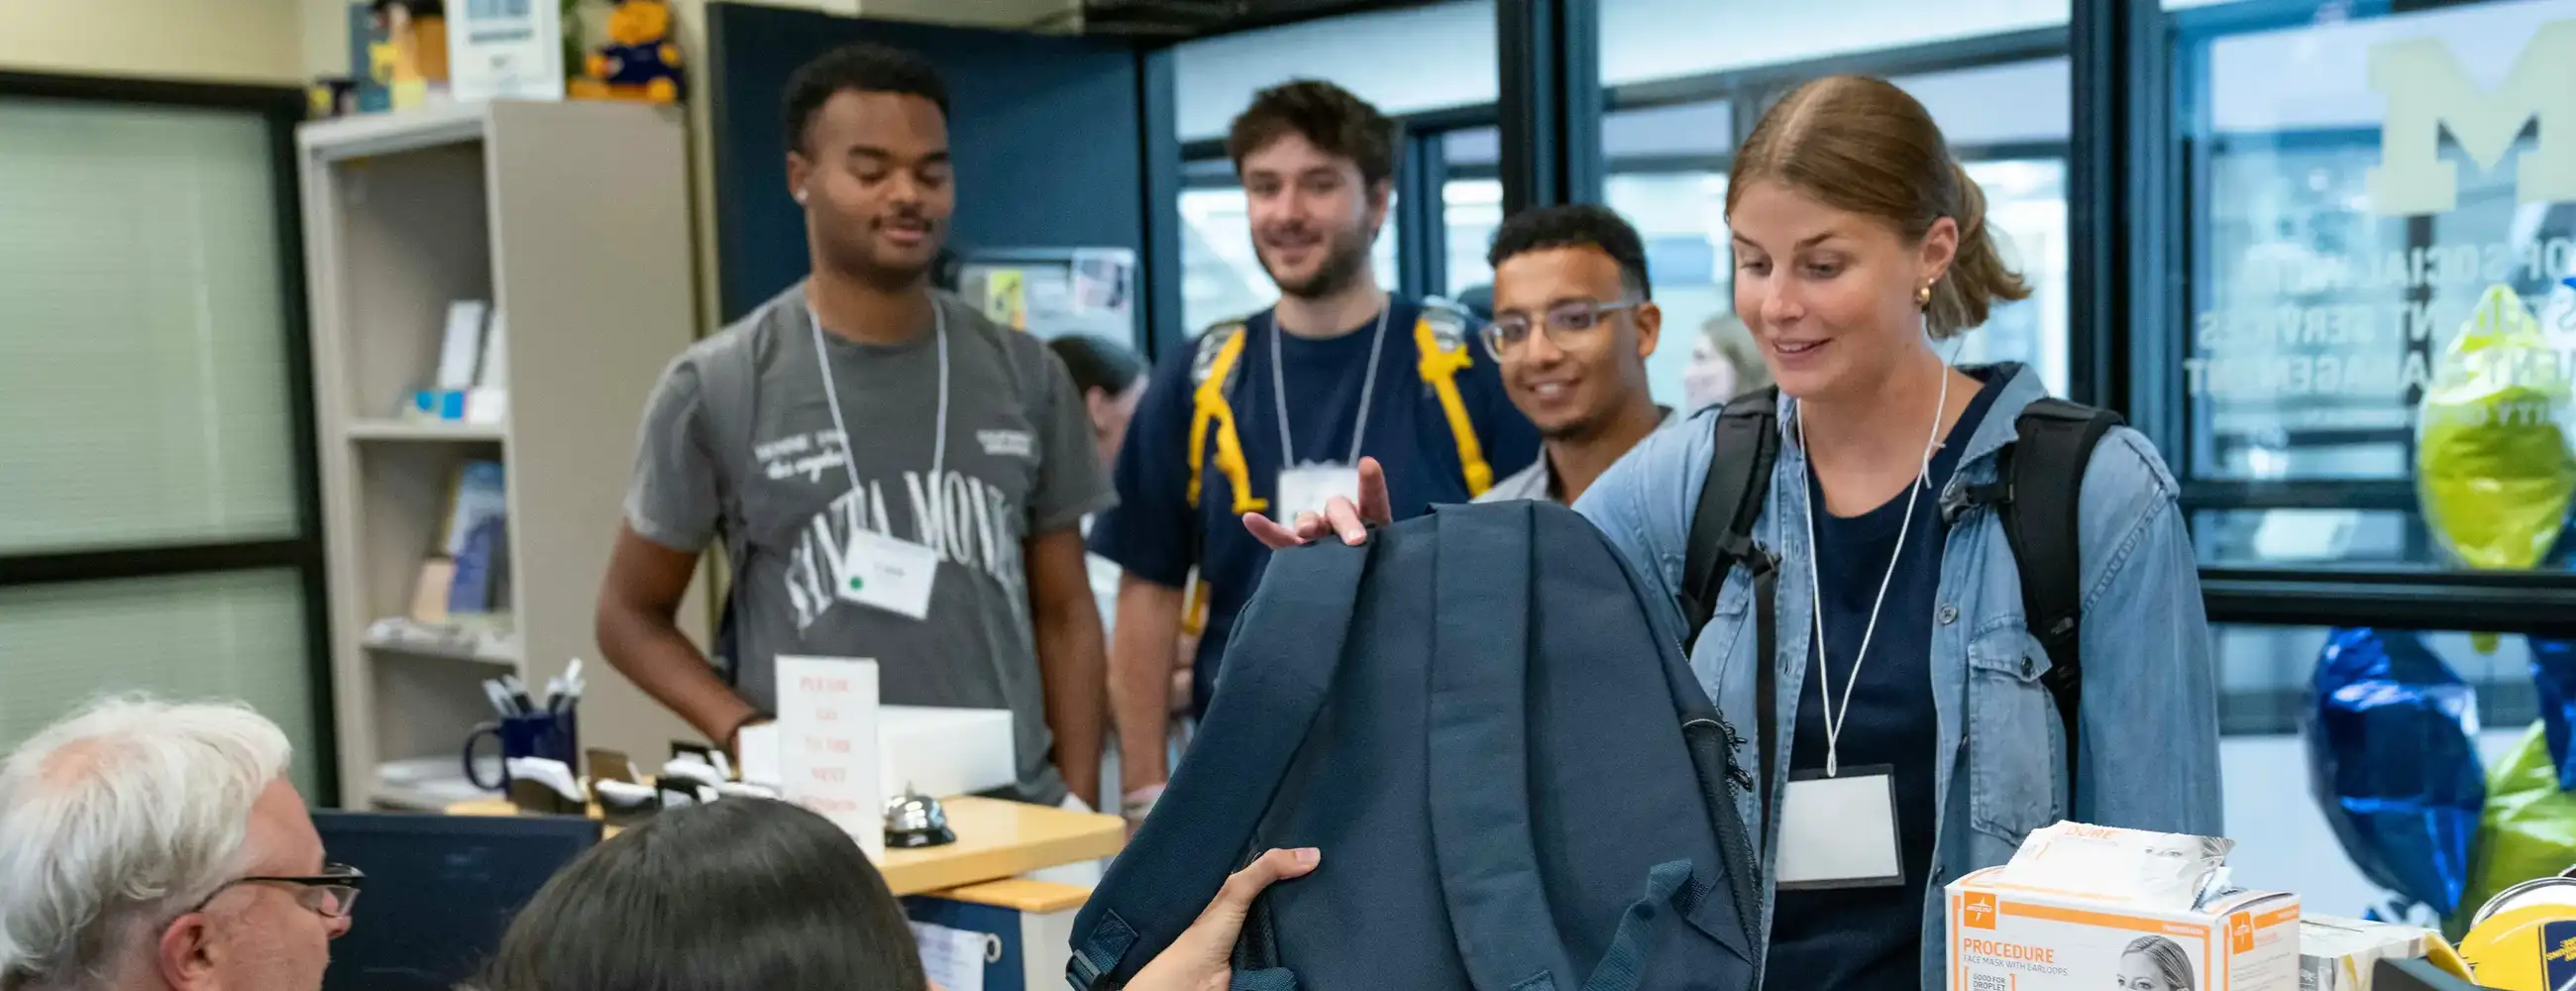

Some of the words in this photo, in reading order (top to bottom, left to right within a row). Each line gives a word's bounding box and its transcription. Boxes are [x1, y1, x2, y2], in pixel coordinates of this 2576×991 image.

[1964, 937, 2055, 964] PROCEDURE
[1964, 954, 1982, 964] FACE
[1983, 957, 2004, 967] MASK
[2005, 960, 2026, 971] WITH
[2027, 963, 2069, 977] EARLOOPS
[1973, 973, 1991, 982] GOOD
[1973, 981, 2006, 991] DROPLET
